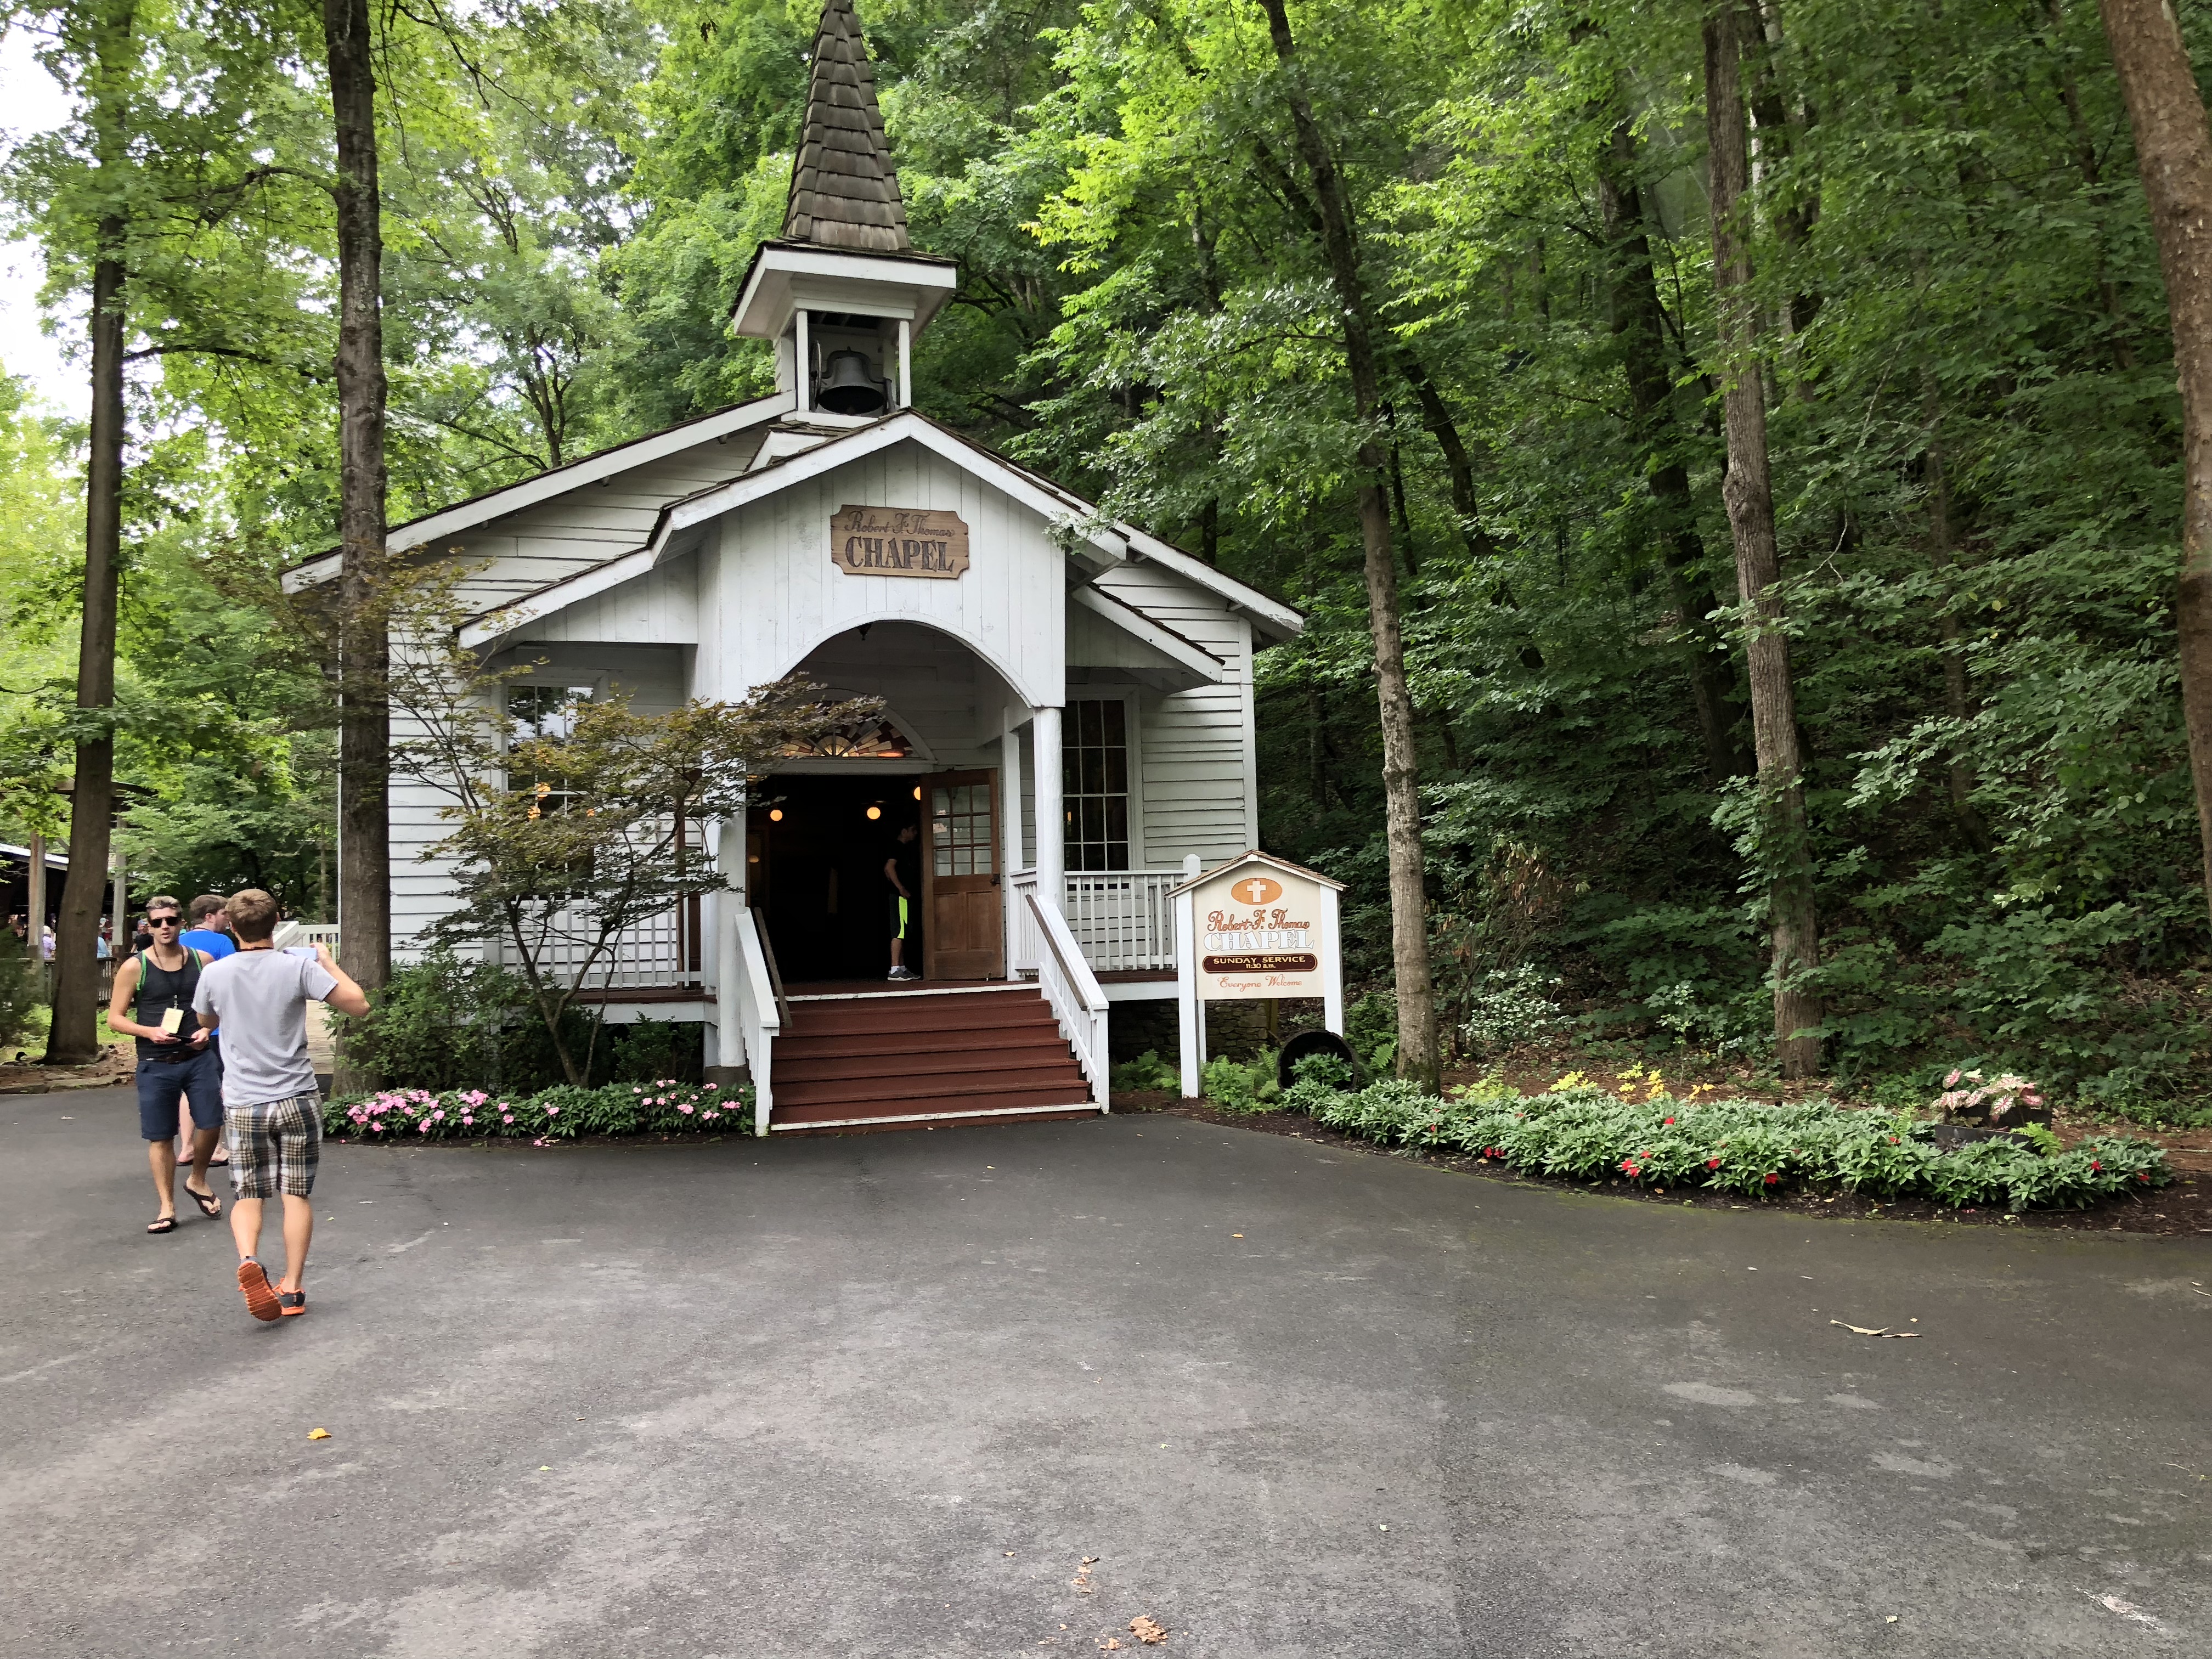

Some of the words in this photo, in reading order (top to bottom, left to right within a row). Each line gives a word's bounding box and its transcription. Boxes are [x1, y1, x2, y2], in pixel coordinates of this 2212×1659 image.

[844, 510, 889, 533] Robert
[907, 512, 955, 537] Thomas
[845, 536, 955, 572] CHAPEL
[1207, 910, 1250, 932] Robert
[1268, 908, 1310, 929] Thomas
[1203, 929, 1314, 951] CHAPEL
[1217, 977, 1261, 992] Everyone
[1265, 974, 1302, 987] Welcome
